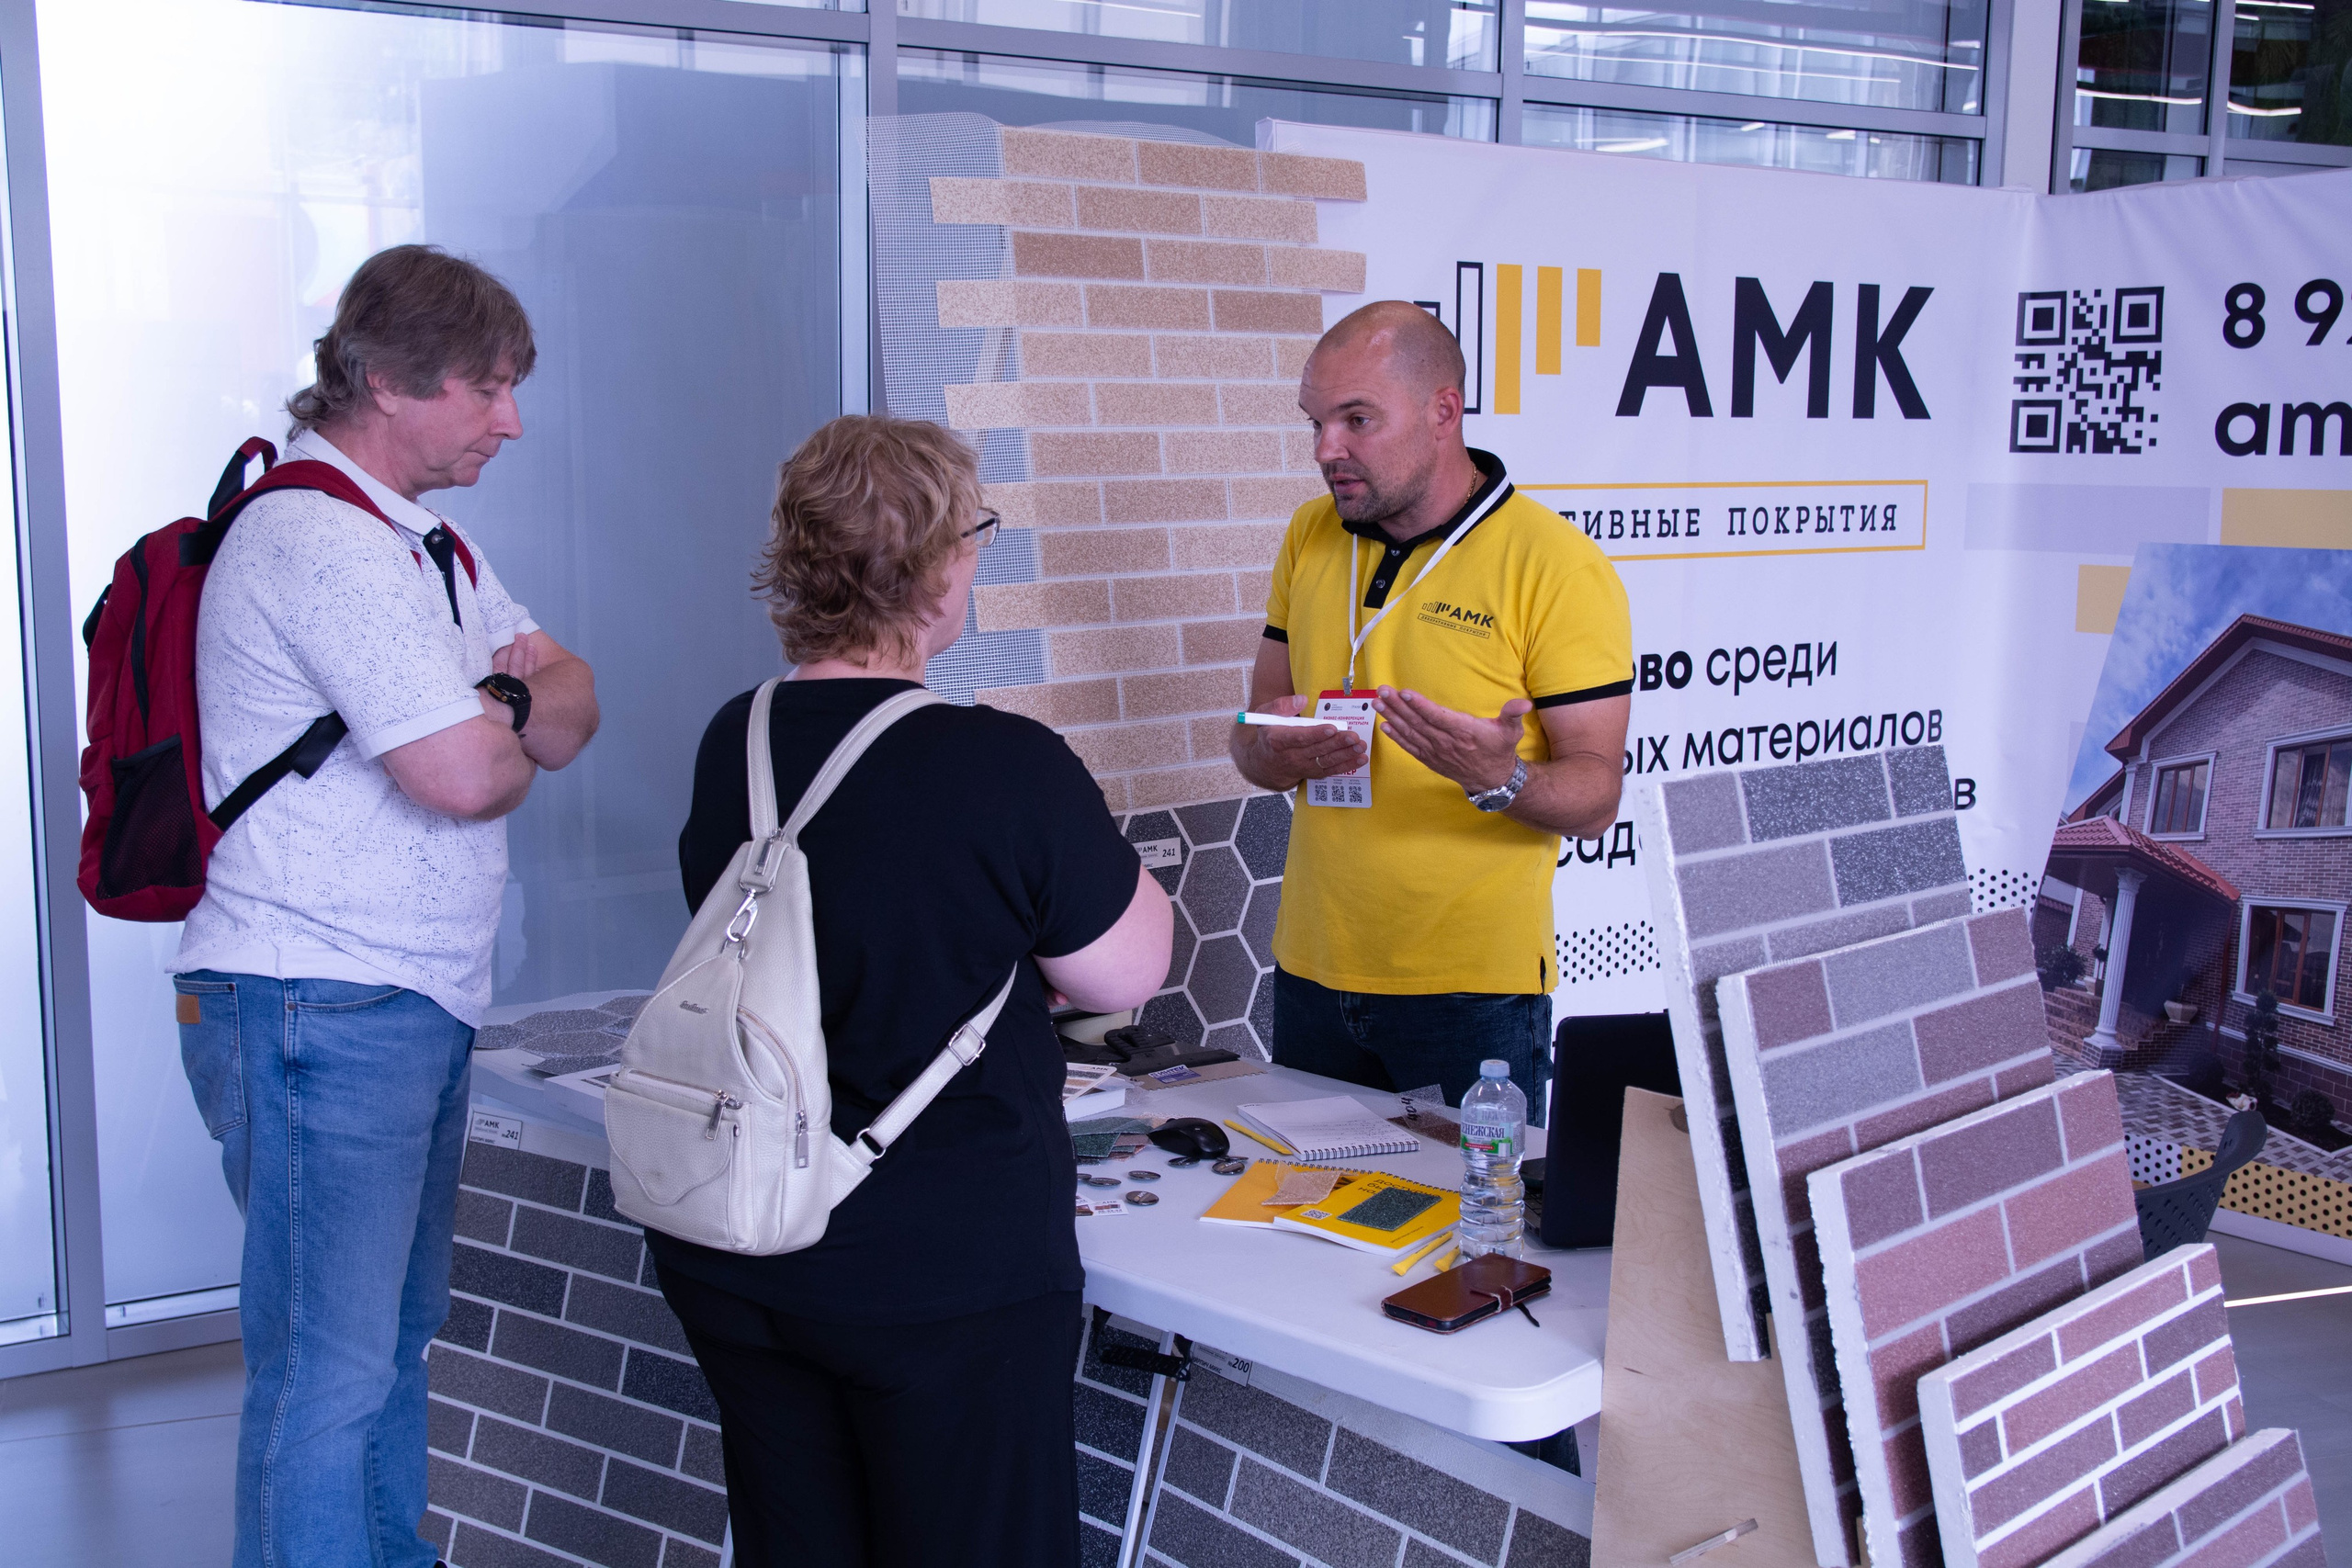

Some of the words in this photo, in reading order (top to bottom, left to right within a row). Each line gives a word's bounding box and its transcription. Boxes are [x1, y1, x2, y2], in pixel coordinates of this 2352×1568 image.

[2222, 282, 2266, 349] 8
[2294, 278, 2352, 346] 9
[1615, 272, 1935, 420] АМК
[1728, 504, 1897, 536] ПОКРЫТИЯ
[1449, 606, 1494, 628] АМК
[1633, 650, 1693, 691] во
[1705, 640, 1838, 695] среди
[1682, 708, 1943, 770] материалов
[1142, 845, 1158, 853] АМК
[1162, 848, 1175, 857] 241
[484, 1120, 500, 1129] АМК
